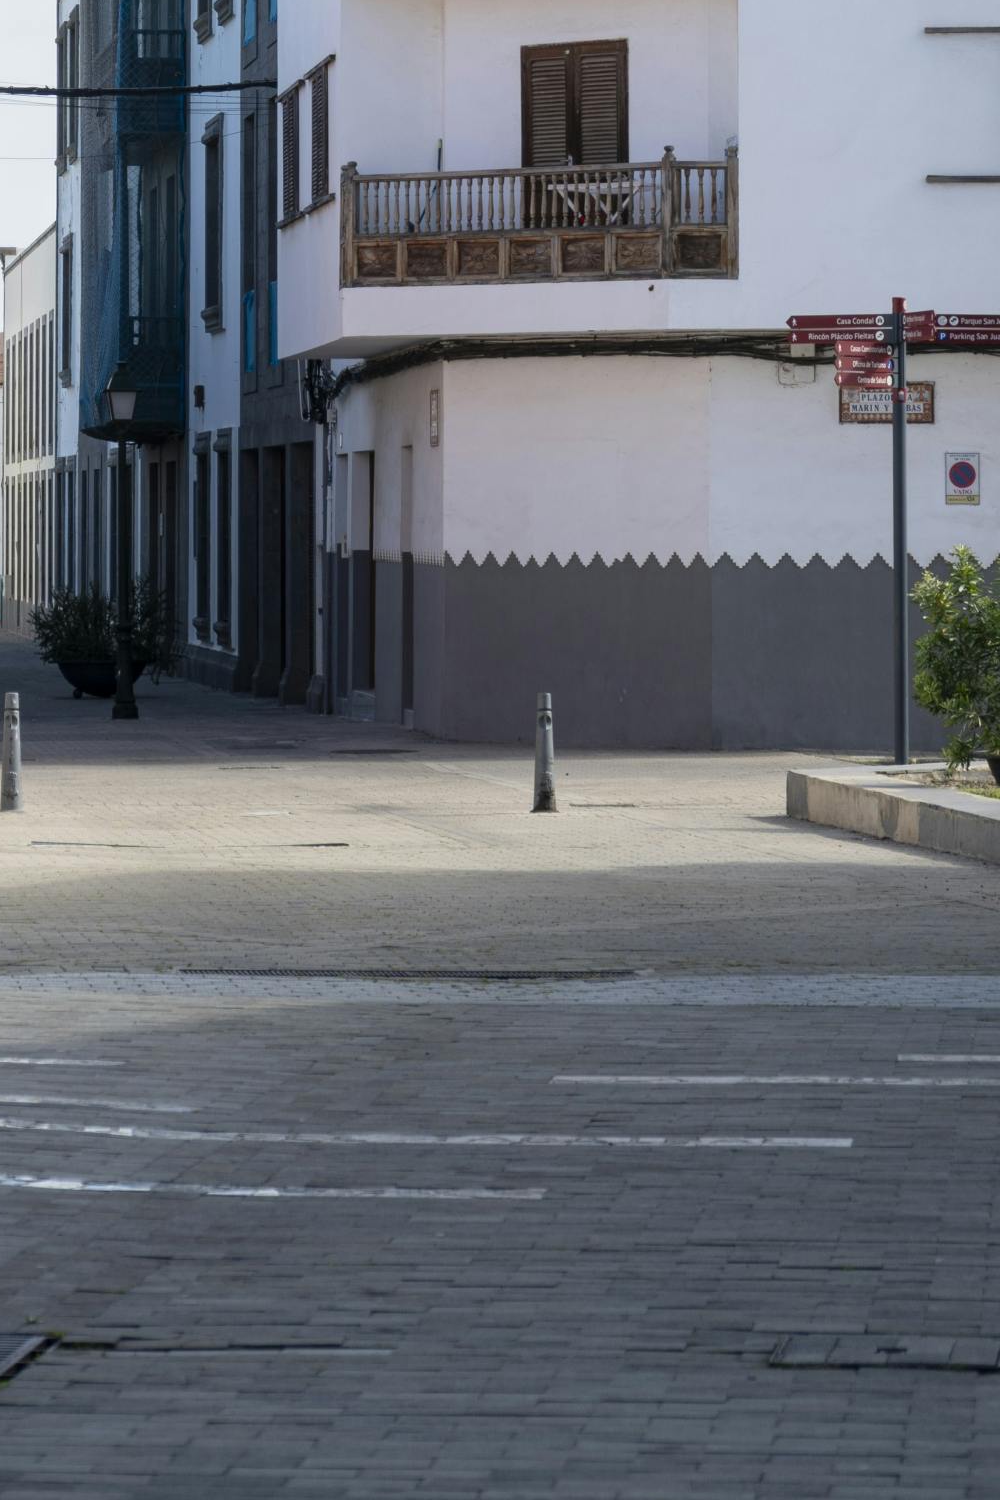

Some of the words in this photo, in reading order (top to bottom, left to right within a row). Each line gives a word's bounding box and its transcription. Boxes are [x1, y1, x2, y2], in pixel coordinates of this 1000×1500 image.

[852, 317, 874, 325] Condal
[960, 318, 982, 327] Parque
[808, 332, 829, 340] Rincón
[830, 332, 853, 340] Plácido
[854, 332, 874, 340] Fleitas
[949, 332, 975, 342] Parking
[851, 404, 880, 412] MARIN
[882, 404, 889, 412] Y
